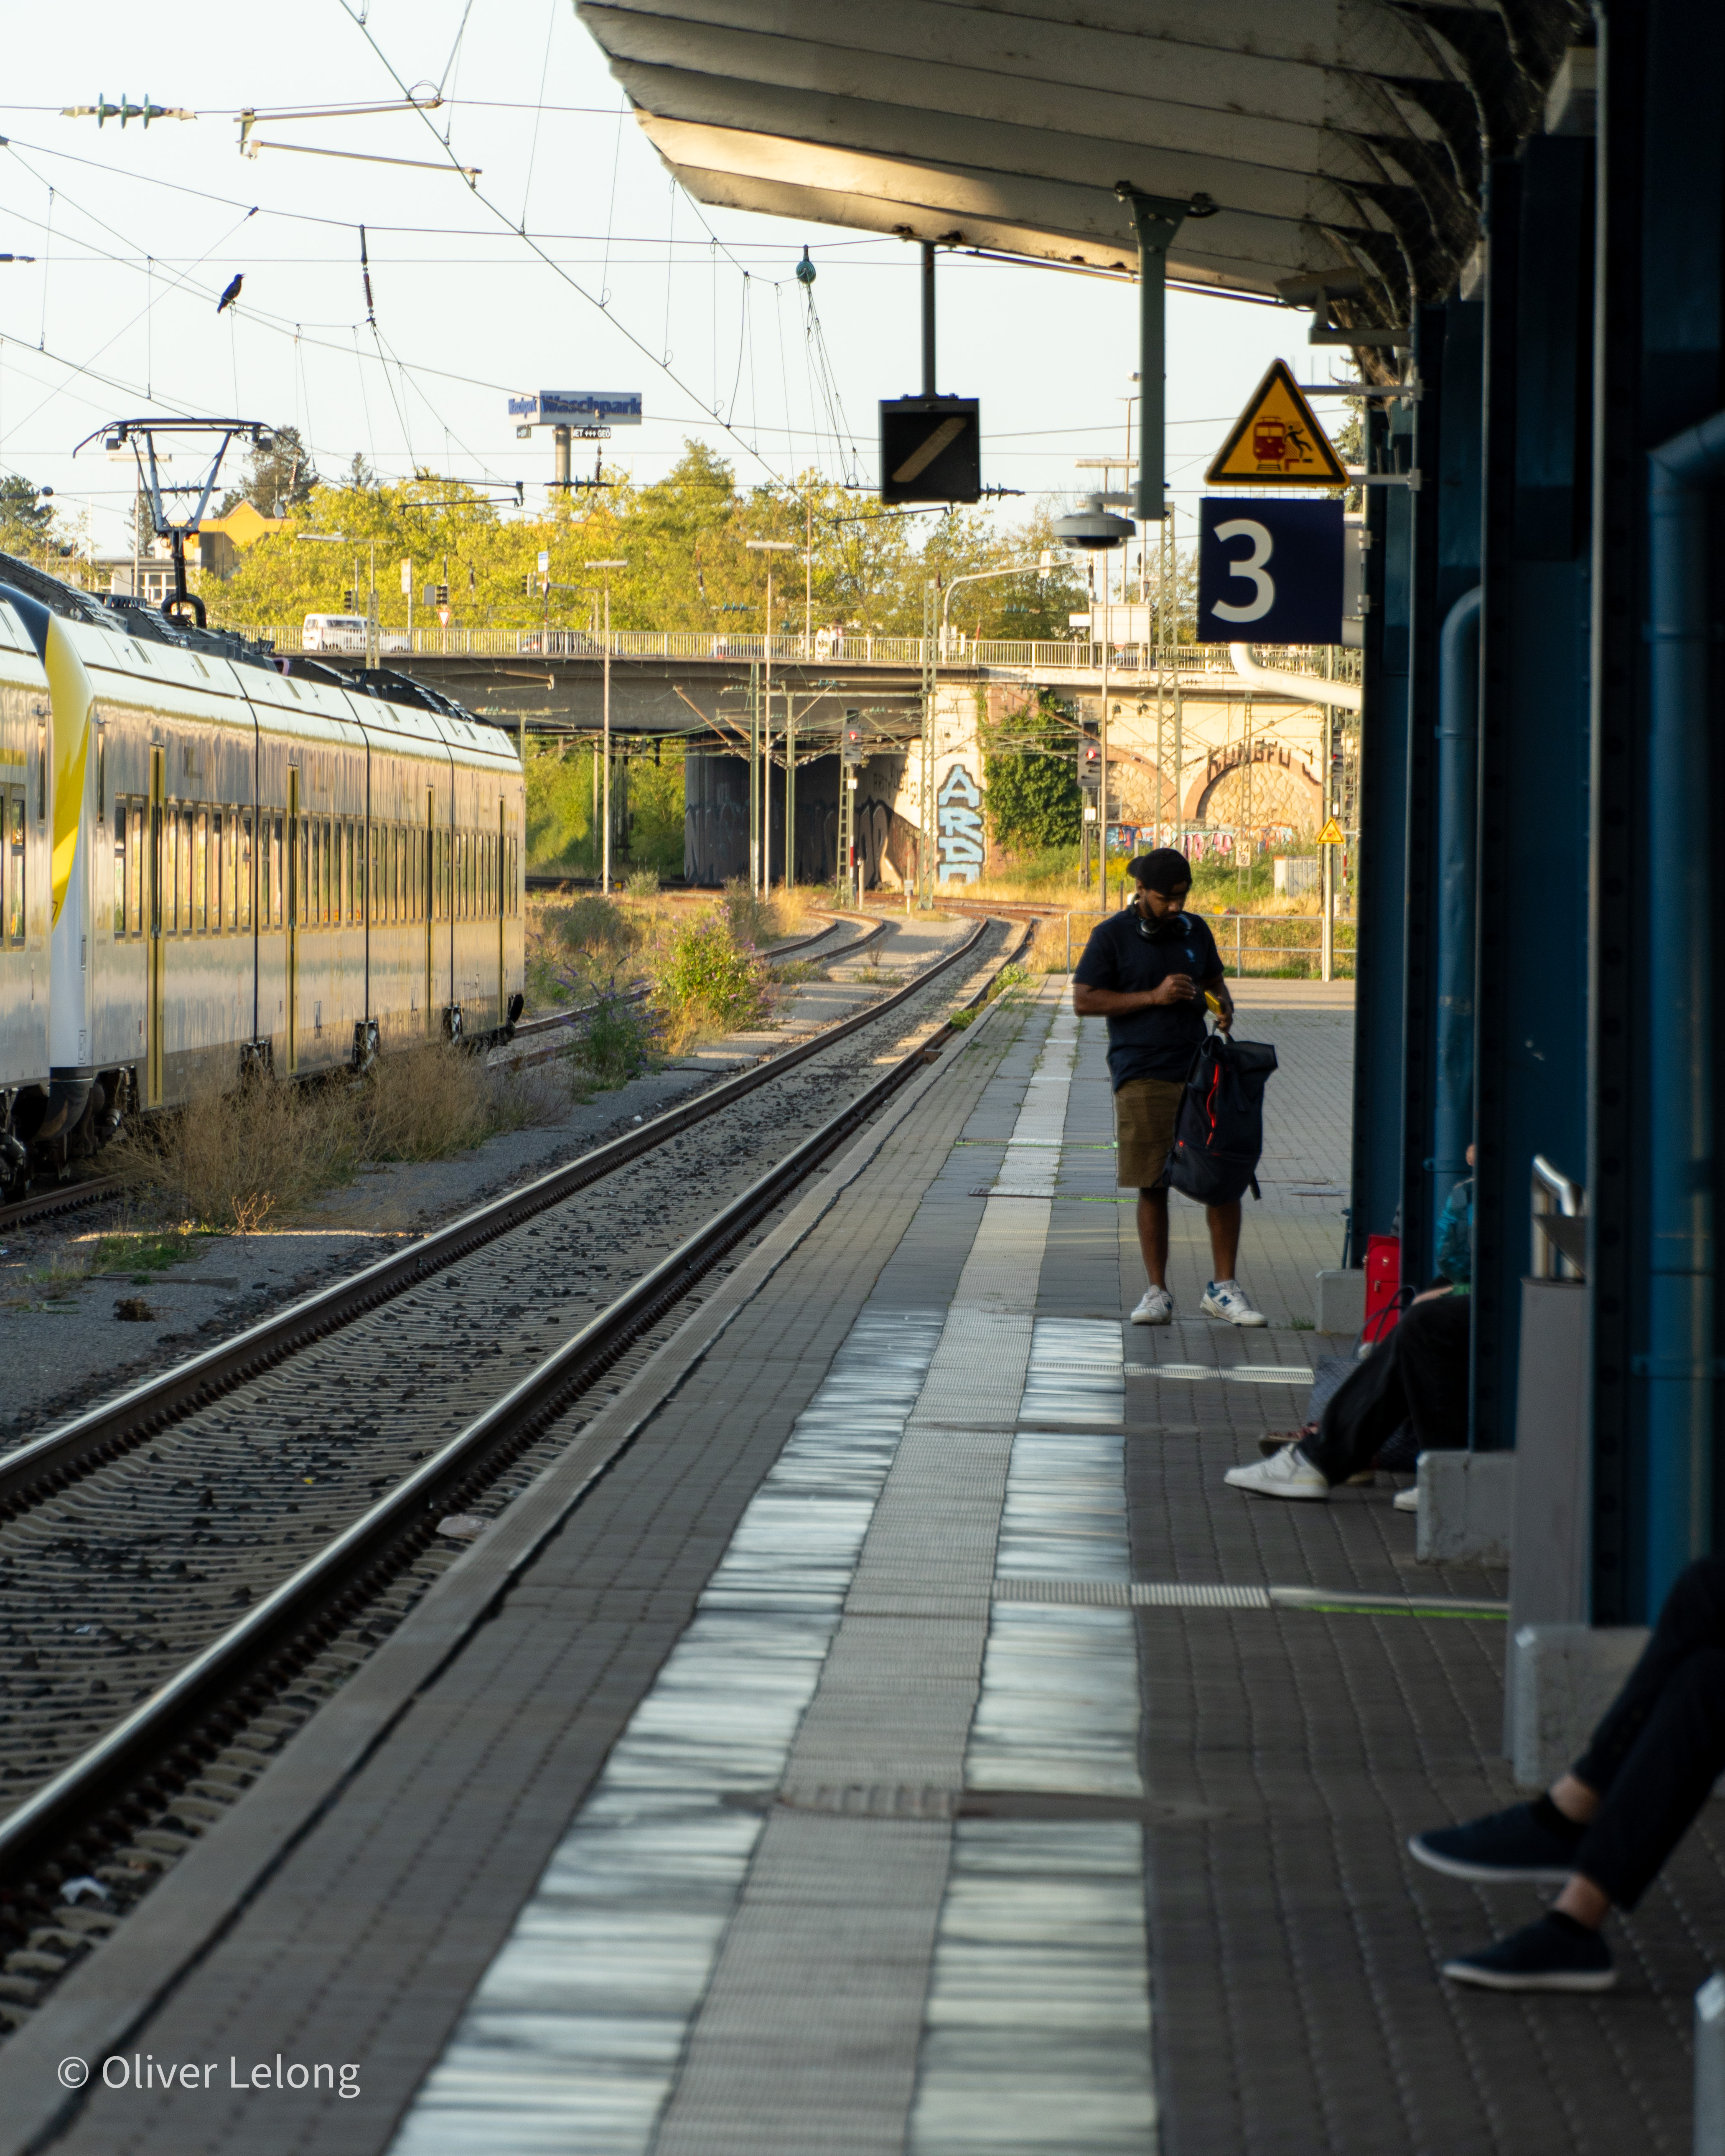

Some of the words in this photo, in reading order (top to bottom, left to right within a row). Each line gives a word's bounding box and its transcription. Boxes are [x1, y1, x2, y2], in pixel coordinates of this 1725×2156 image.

[541, 395, 642, 419] Waschpark
[598, 428, 611, 437] GEÖ
[1210, 518, 1276, 623] 3
[1238, 844, 1249, 853] 34
